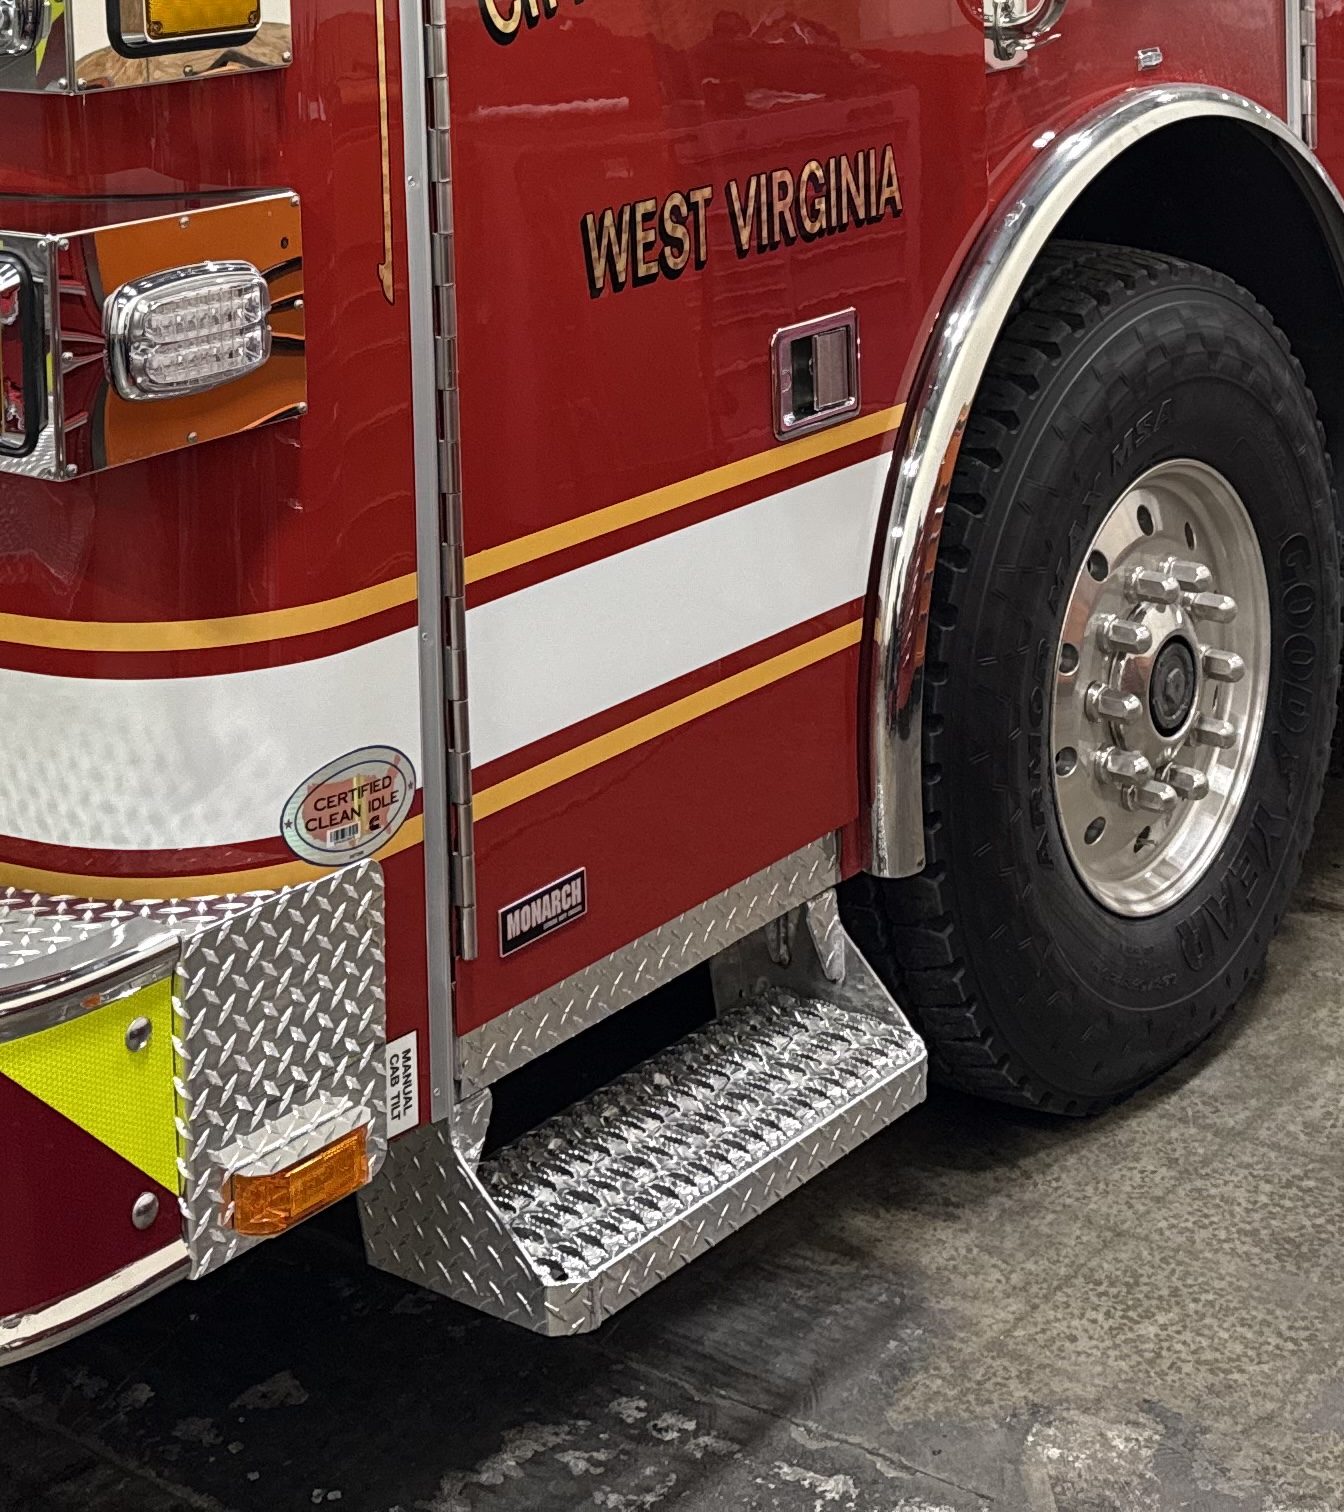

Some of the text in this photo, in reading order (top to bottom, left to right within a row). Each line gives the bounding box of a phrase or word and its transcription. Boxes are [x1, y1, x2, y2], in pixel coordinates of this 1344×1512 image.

[580, 143, 903, 299] WEST VIRGINIA
[305, 790, 400, 832] CLEAN IDLE
[313, 775, 392, 812] CERTIFIED
[506, 877, 583, 942] MONARCH
[389, 1053, 401, 1121] CAB TILT
[401, 1047, 413, 1117] MANUAL
